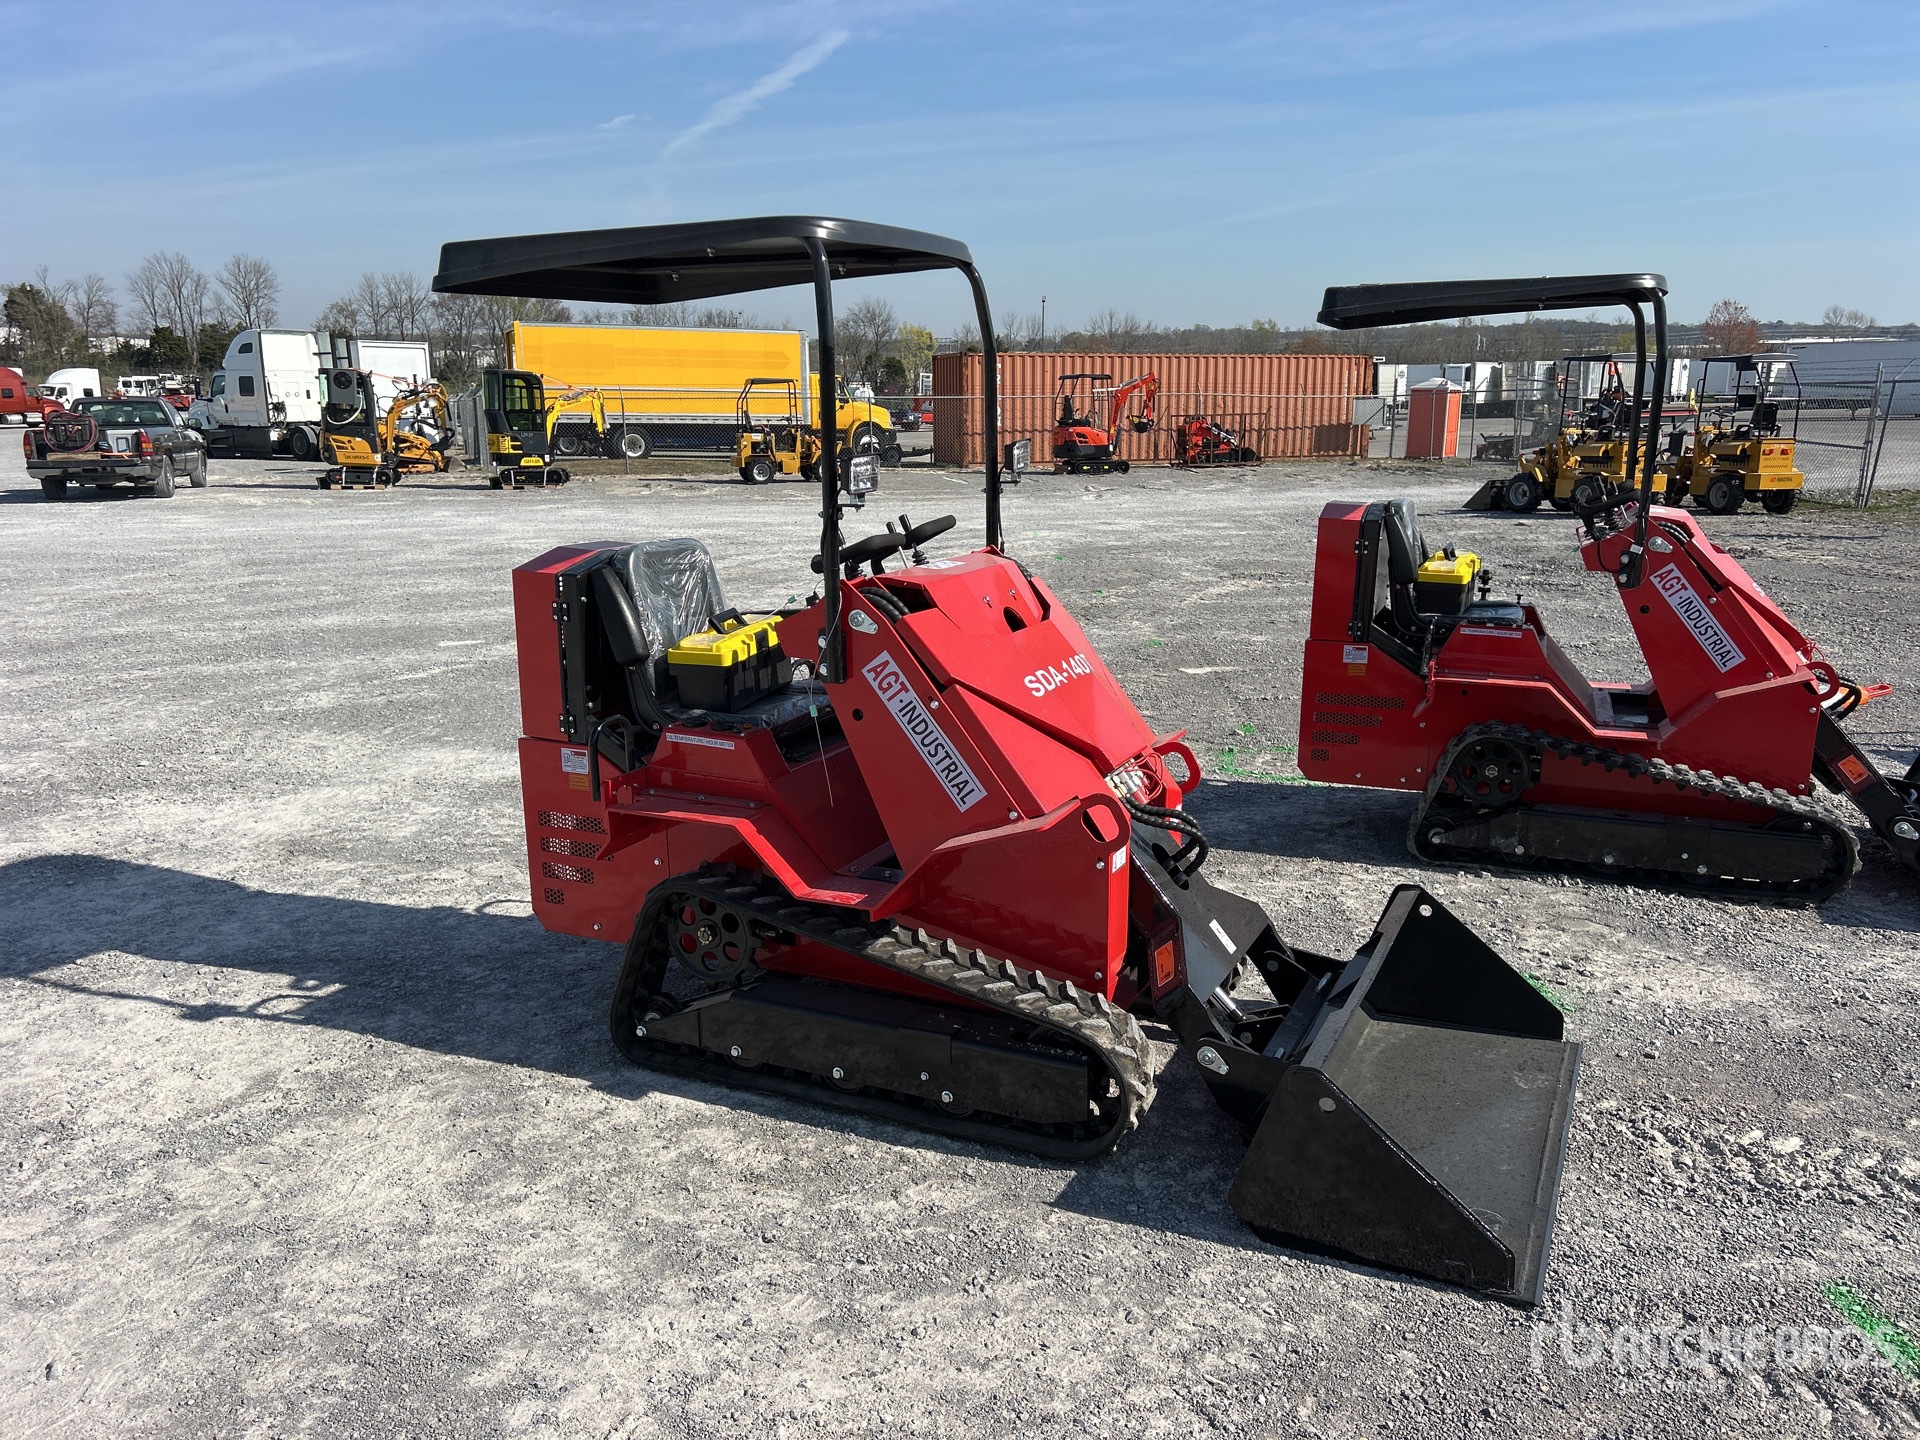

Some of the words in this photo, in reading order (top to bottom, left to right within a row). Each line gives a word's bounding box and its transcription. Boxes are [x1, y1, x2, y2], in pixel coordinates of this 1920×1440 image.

[1653, 568, 1689, 598] AGT
[1677, 596, 1736, 668] INDUSTRIAL
[1023, 653, 1095, 697] SDA-140T
[866, 659, 910, 702] AGT
[898, 700, 976, 805] INDUSTRIAL
